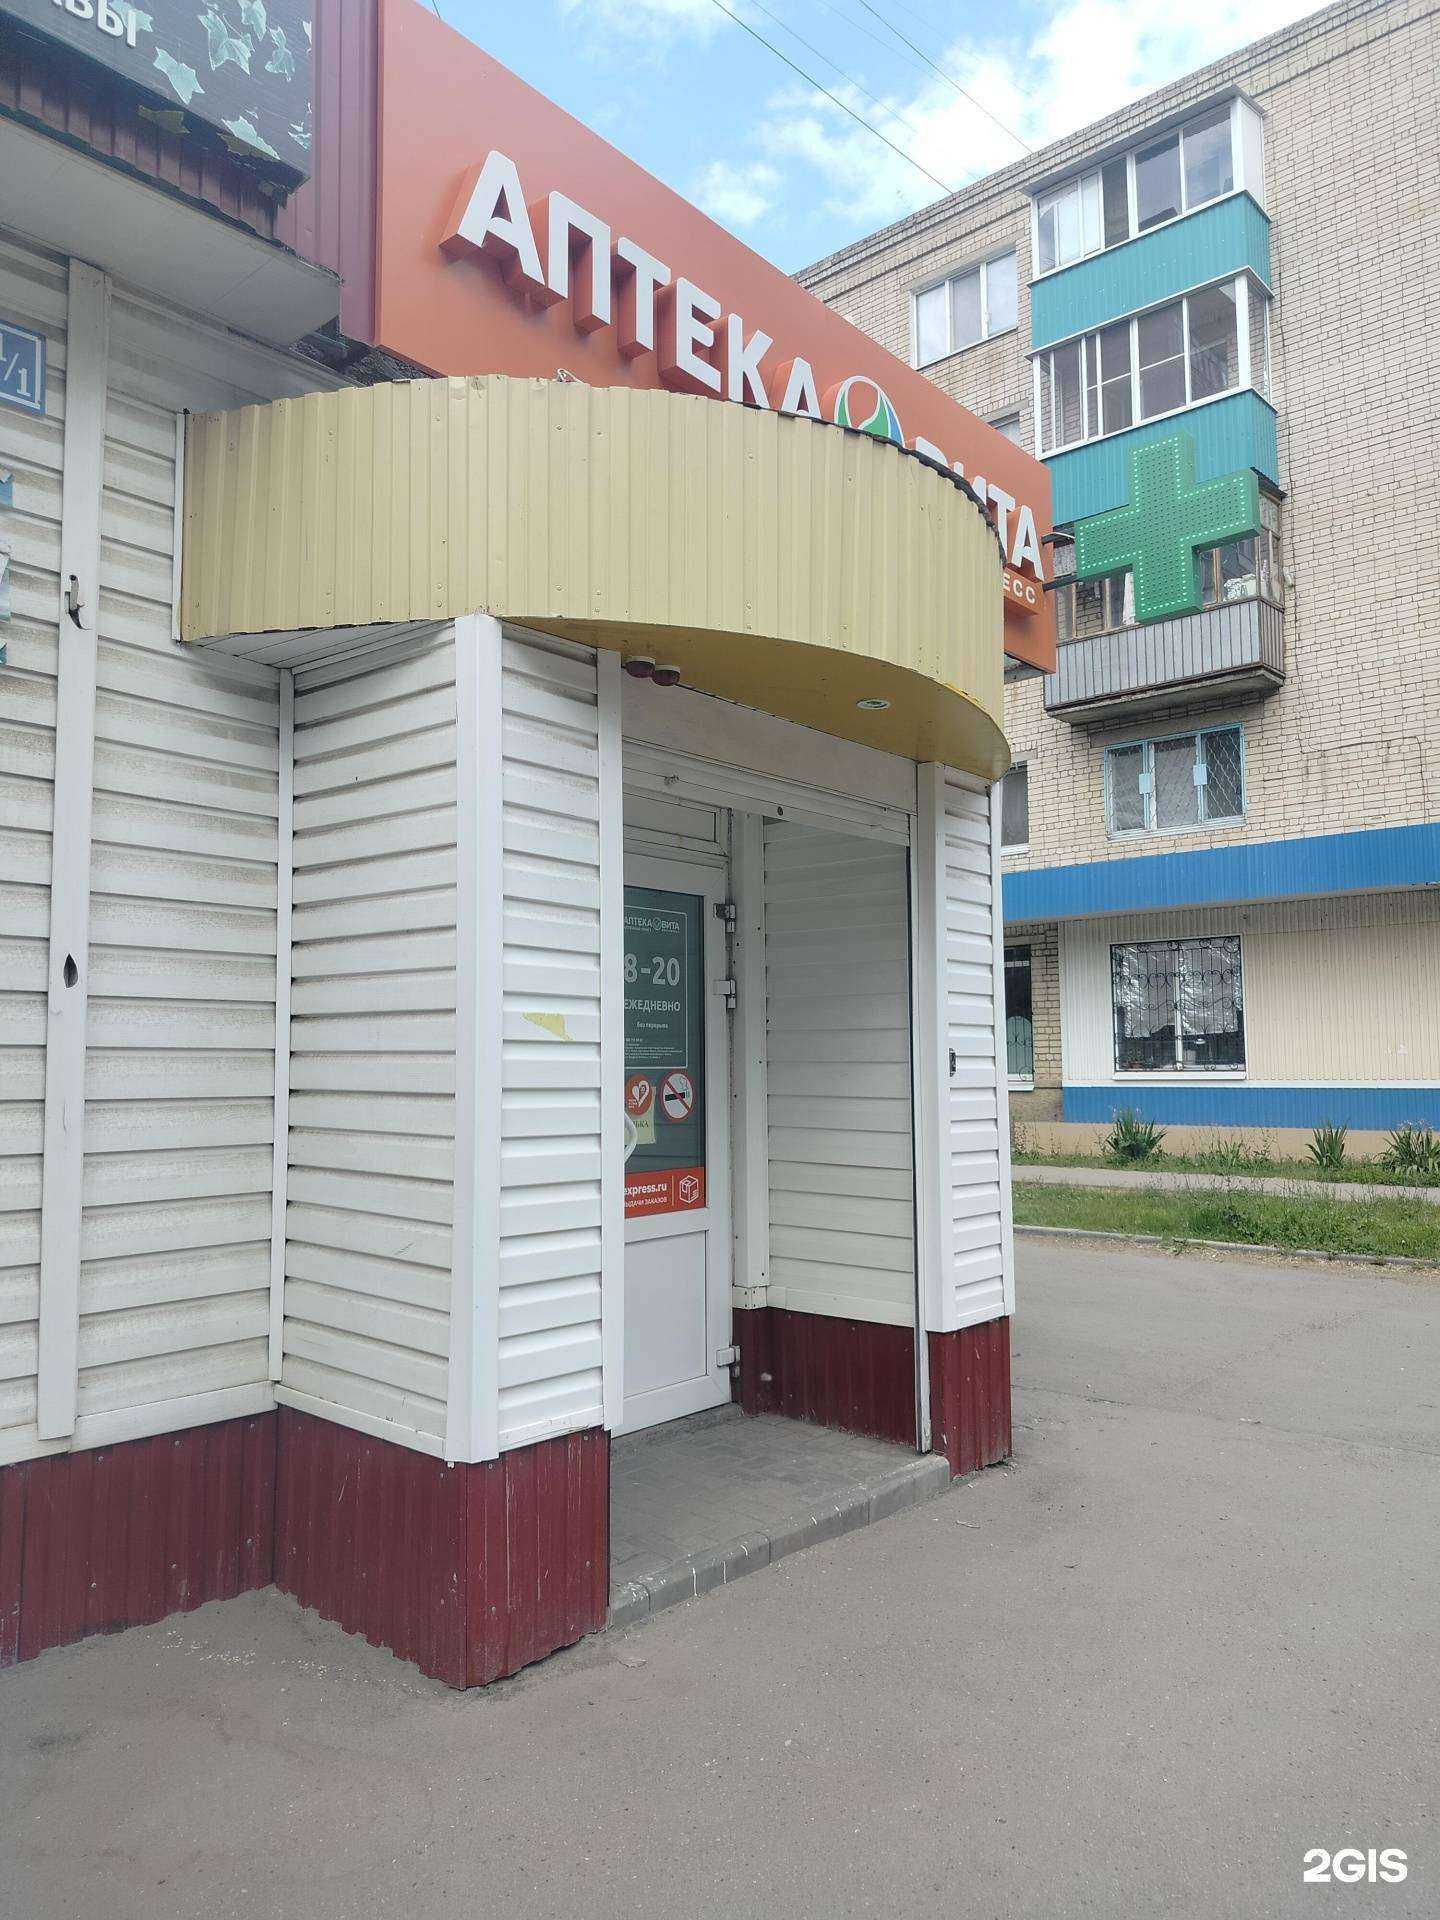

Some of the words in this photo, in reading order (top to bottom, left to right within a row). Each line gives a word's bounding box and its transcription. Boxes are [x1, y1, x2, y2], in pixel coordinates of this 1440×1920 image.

[457, 149, 822, 420] АПТЕКА
[915, 436, 1045, 581] ТА
[624, 999, 680, 1013] ЕЖЕДНЕВНО
